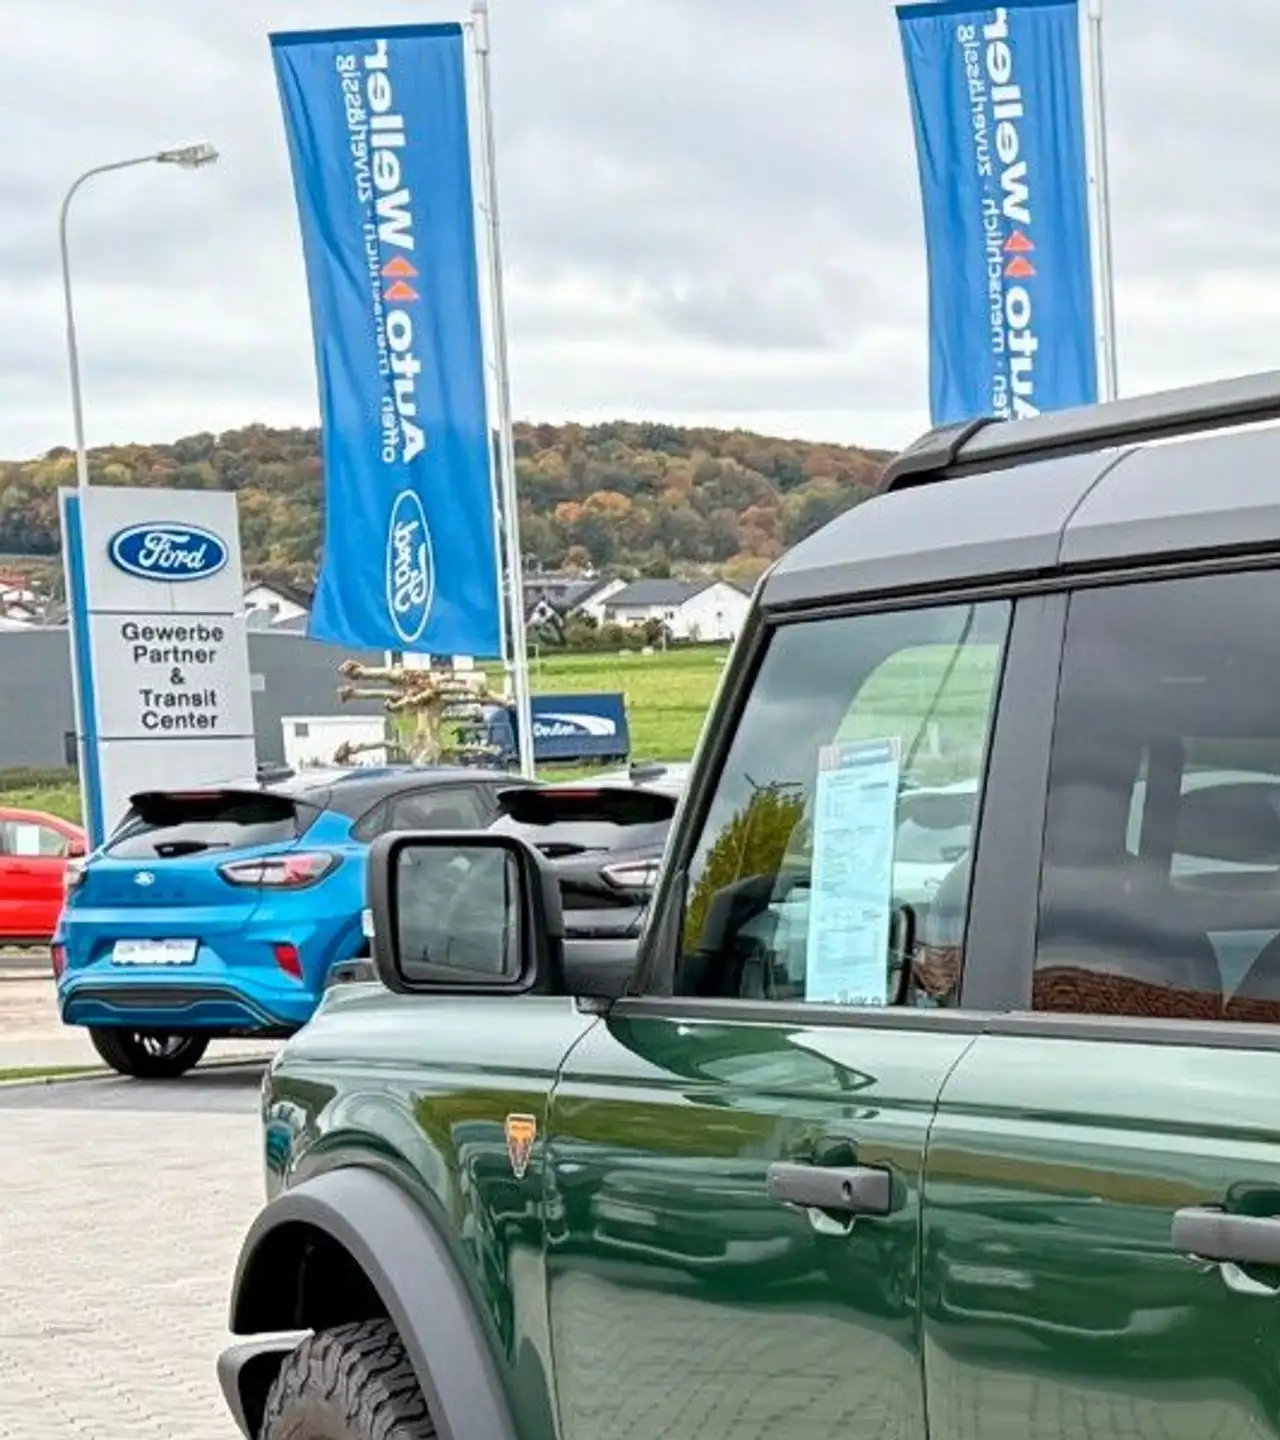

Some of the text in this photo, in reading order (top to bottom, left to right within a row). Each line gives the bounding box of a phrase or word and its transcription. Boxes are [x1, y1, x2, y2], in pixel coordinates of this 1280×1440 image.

[121, 621, 224, 642] Gewerbe
[133, 645, 216, 664] Partner
[170, 667, 185, 685] &
[139, 689, 217, 708] Transit
[141, 711, 218, 729] Center
